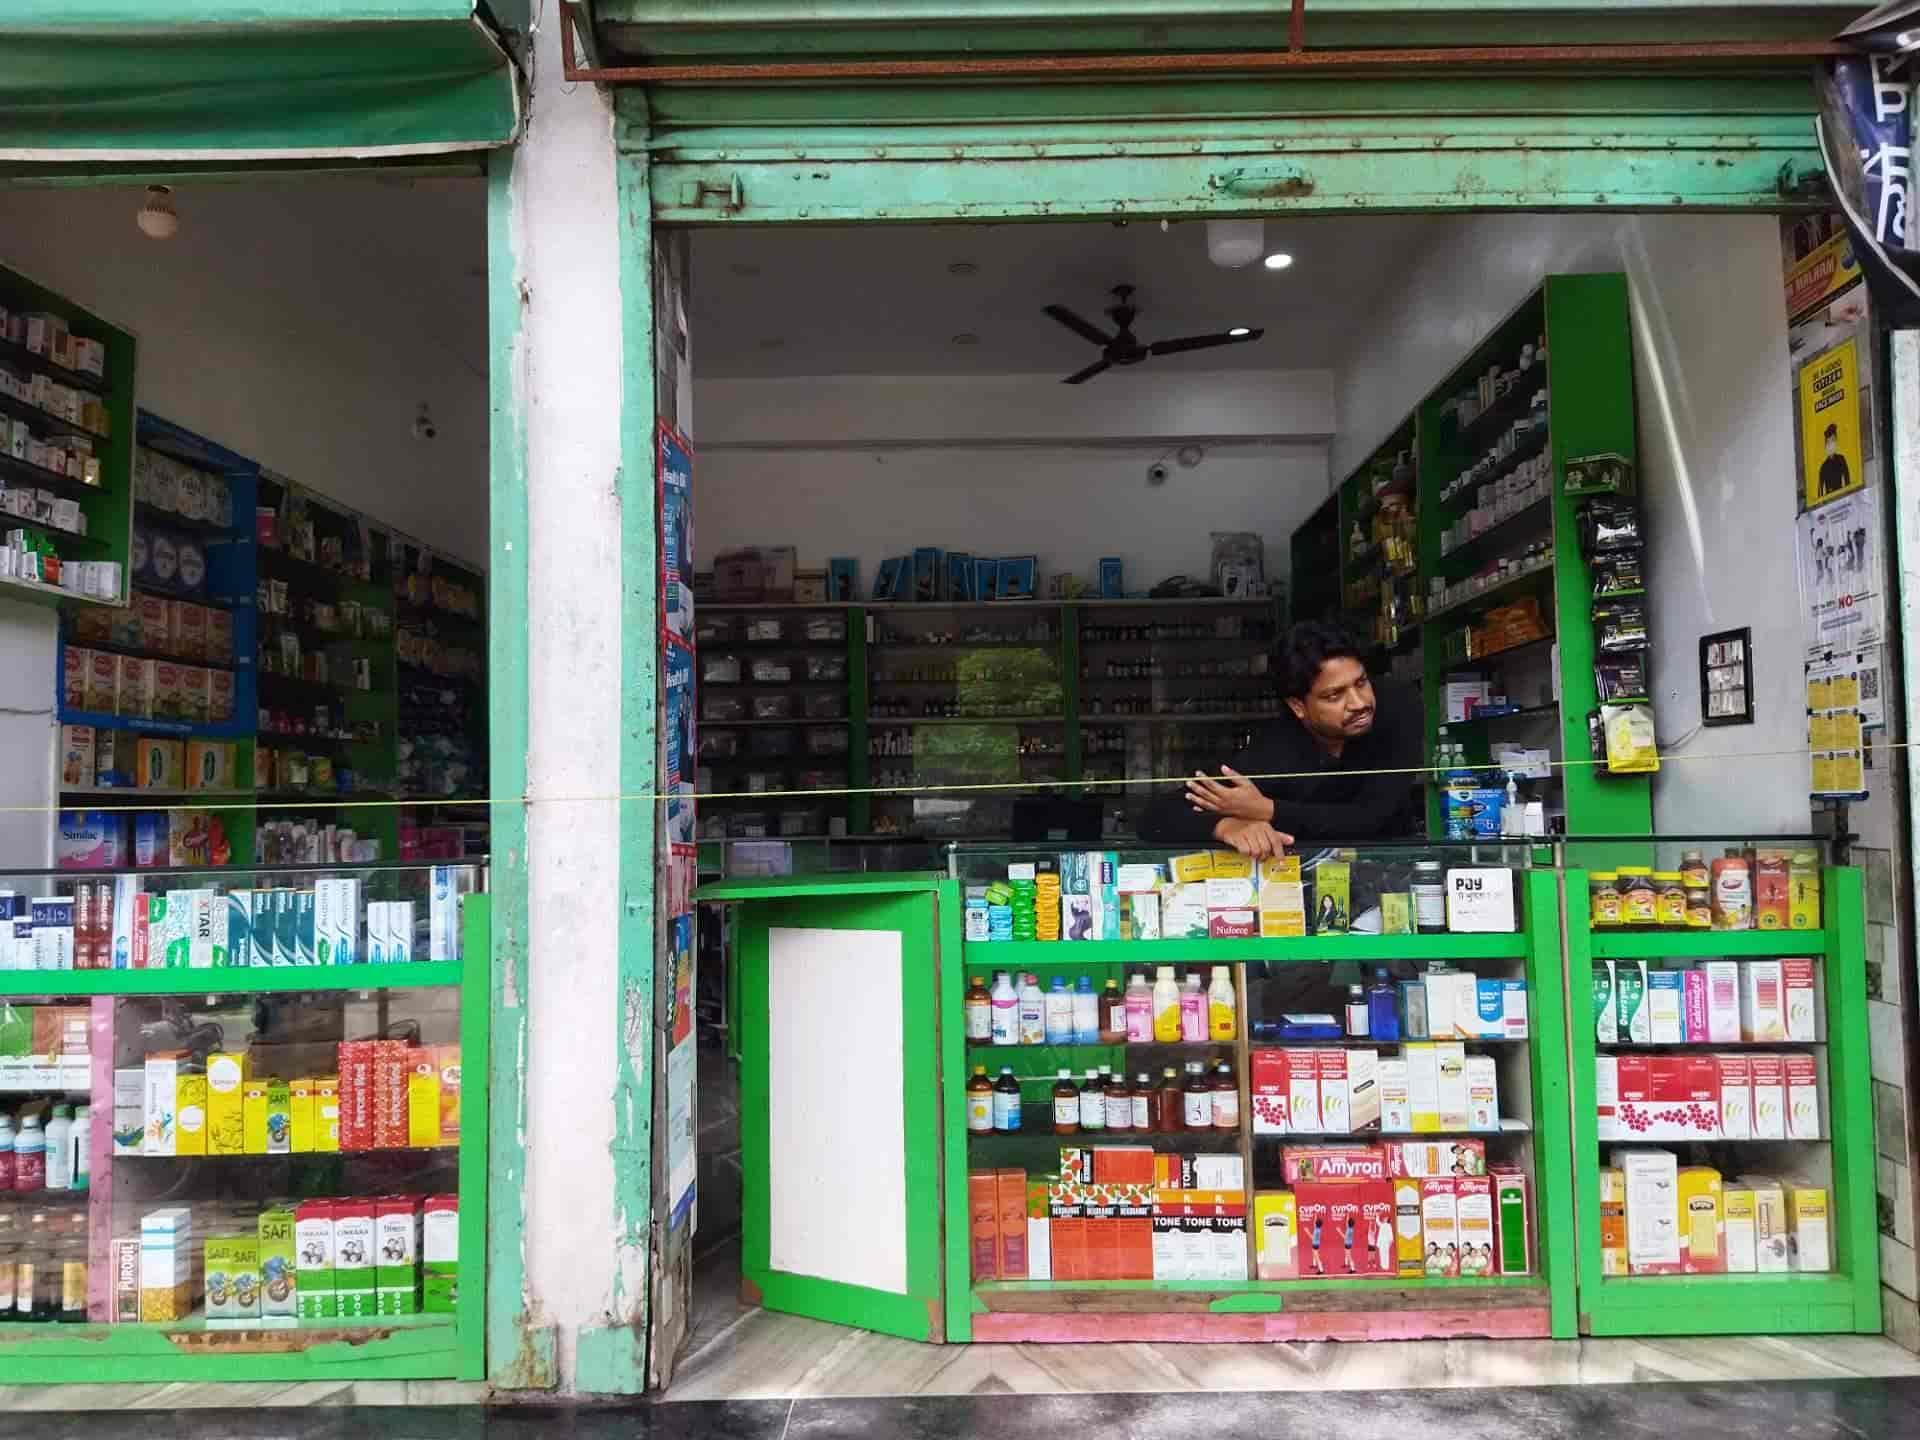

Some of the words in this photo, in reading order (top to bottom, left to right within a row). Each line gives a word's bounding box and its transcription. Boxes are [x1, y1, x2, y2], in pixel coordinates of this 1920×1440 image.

[1183, 1160, 1191, 1187] TONE
[1319, 1158, 1382, 1178] Amyron
[1154, 1217, 1181, 1226] TONE
[1185, 1218, 1213, 1227] TONE
[1216, 1218, 1244, 1227] TONE
[263, 1223, 291, 1240] SAFI
